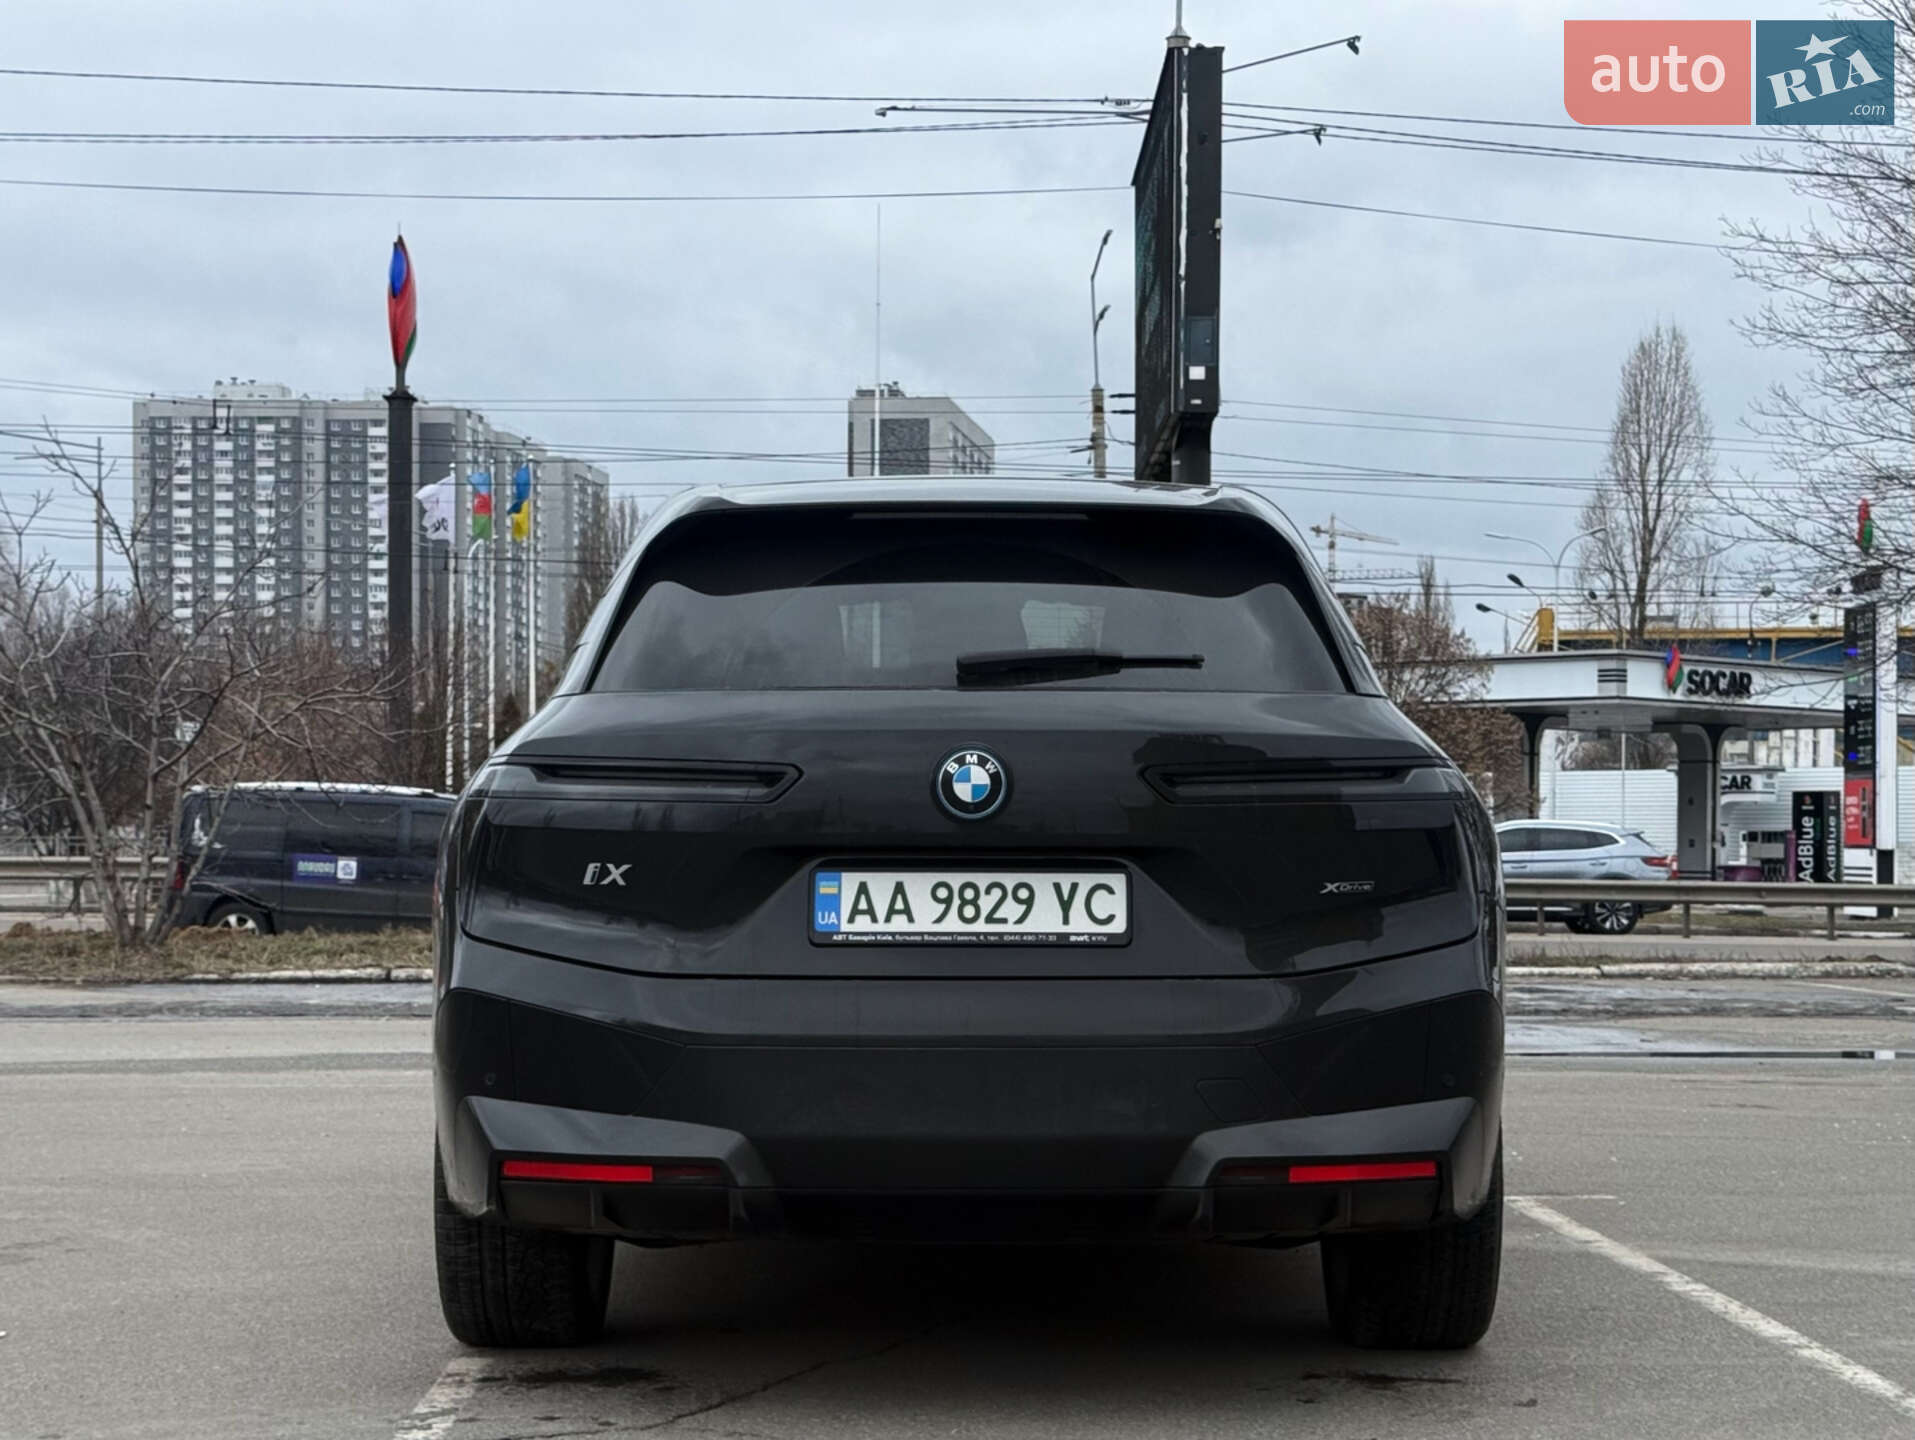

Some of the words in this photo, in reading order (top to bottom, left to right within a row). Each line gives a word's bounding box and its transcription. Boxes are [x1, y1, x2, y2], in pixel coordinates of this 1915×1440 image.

[1686, 669, 1752, 699] SOCAR
[946, 754, 998, 774] BMW
[1797, 816, 1815, 883] AdBlue
[1826, 816, 1837, 882] AdBlue
[818, 911, 838, 925] UA
[847, 881, 915, 925] AA
[930, 881, 1036, 925] 9829
[1052, 881, 1117, 926] YC
